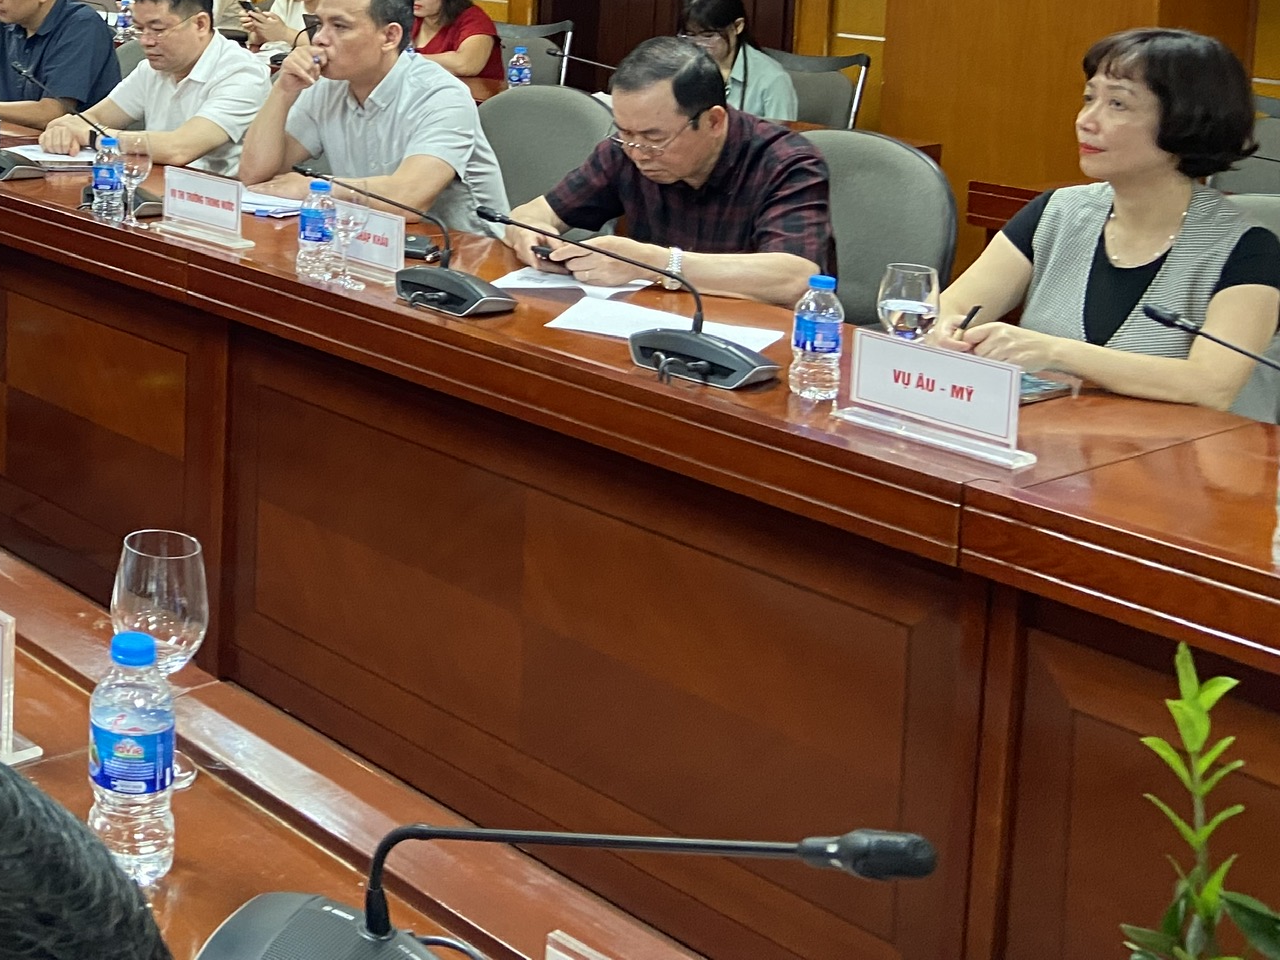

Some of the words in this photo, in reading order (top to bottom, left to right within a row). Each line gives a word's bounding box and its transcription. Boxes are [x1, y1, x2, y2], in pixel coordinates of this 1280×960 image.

[893, 368, 911, 389] VỤ
[915, 372, 935, 393] ÂU
[950, 384, 974, 402] MỸ
